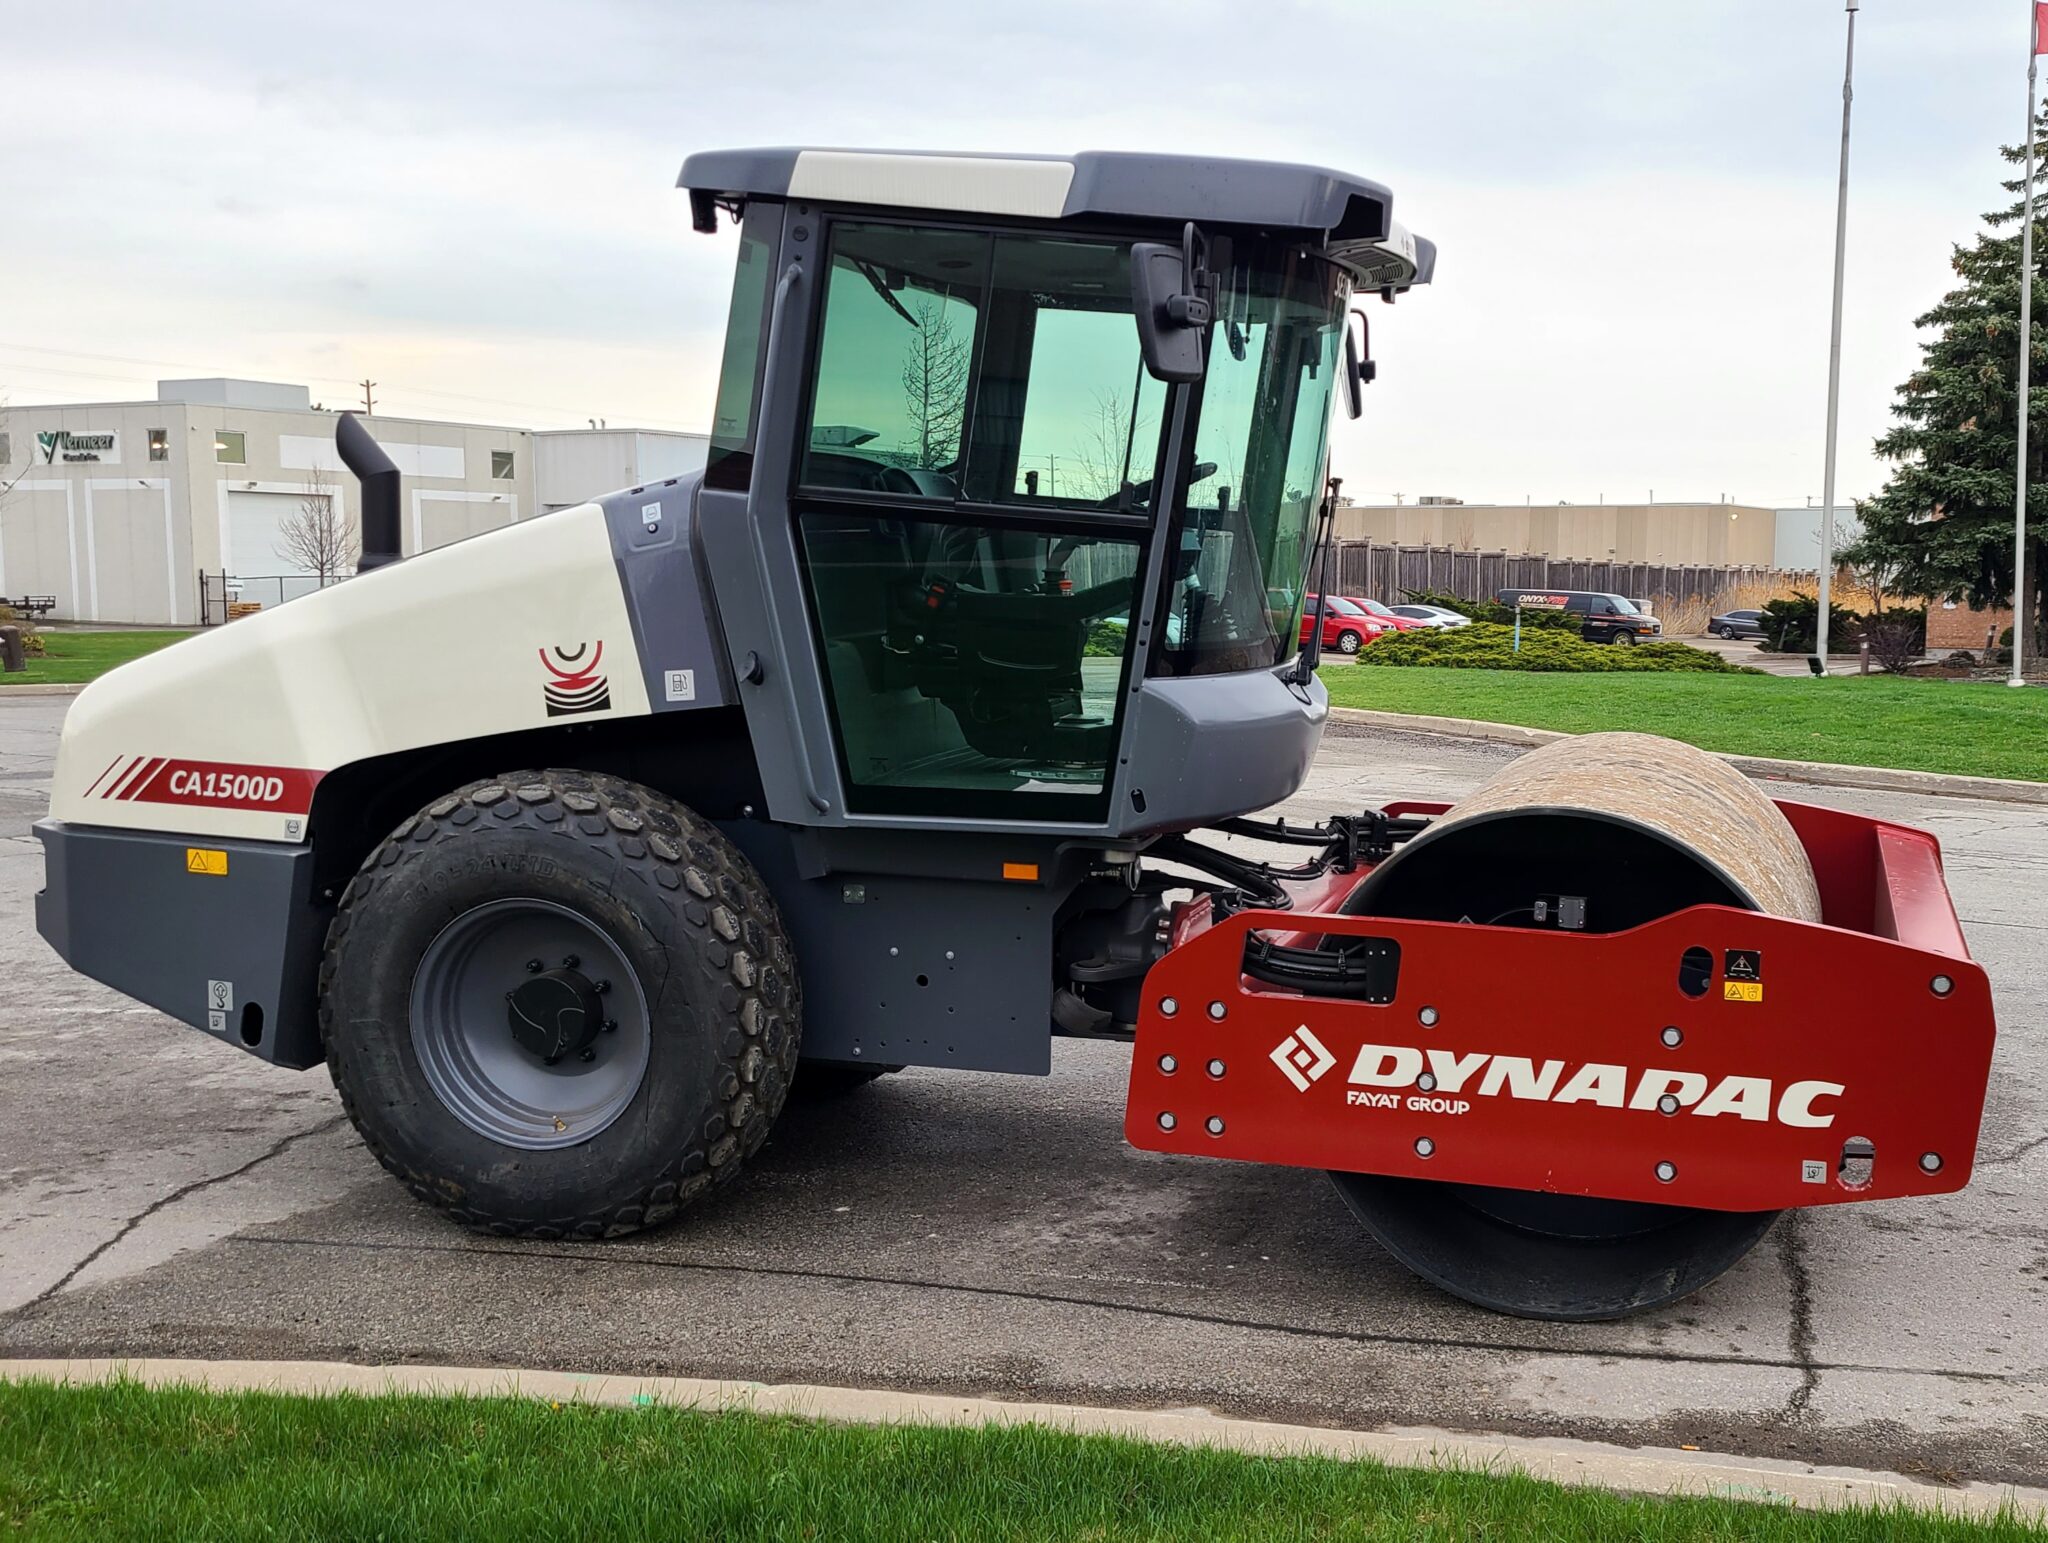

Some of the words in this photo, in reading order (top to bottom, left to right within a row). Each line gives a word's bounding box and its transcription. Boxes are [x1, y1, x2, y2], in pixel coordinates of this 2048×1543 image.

[59, 430, 114, 450] Vermeer
[169, 770, 284, 801] CA1500D
[1347, 1044, 1845, 1128] DYNAPAC
[1347, 1091, 1401, 1109] FAYAT
[1406, 1096, 1470, 1115] GROUP
